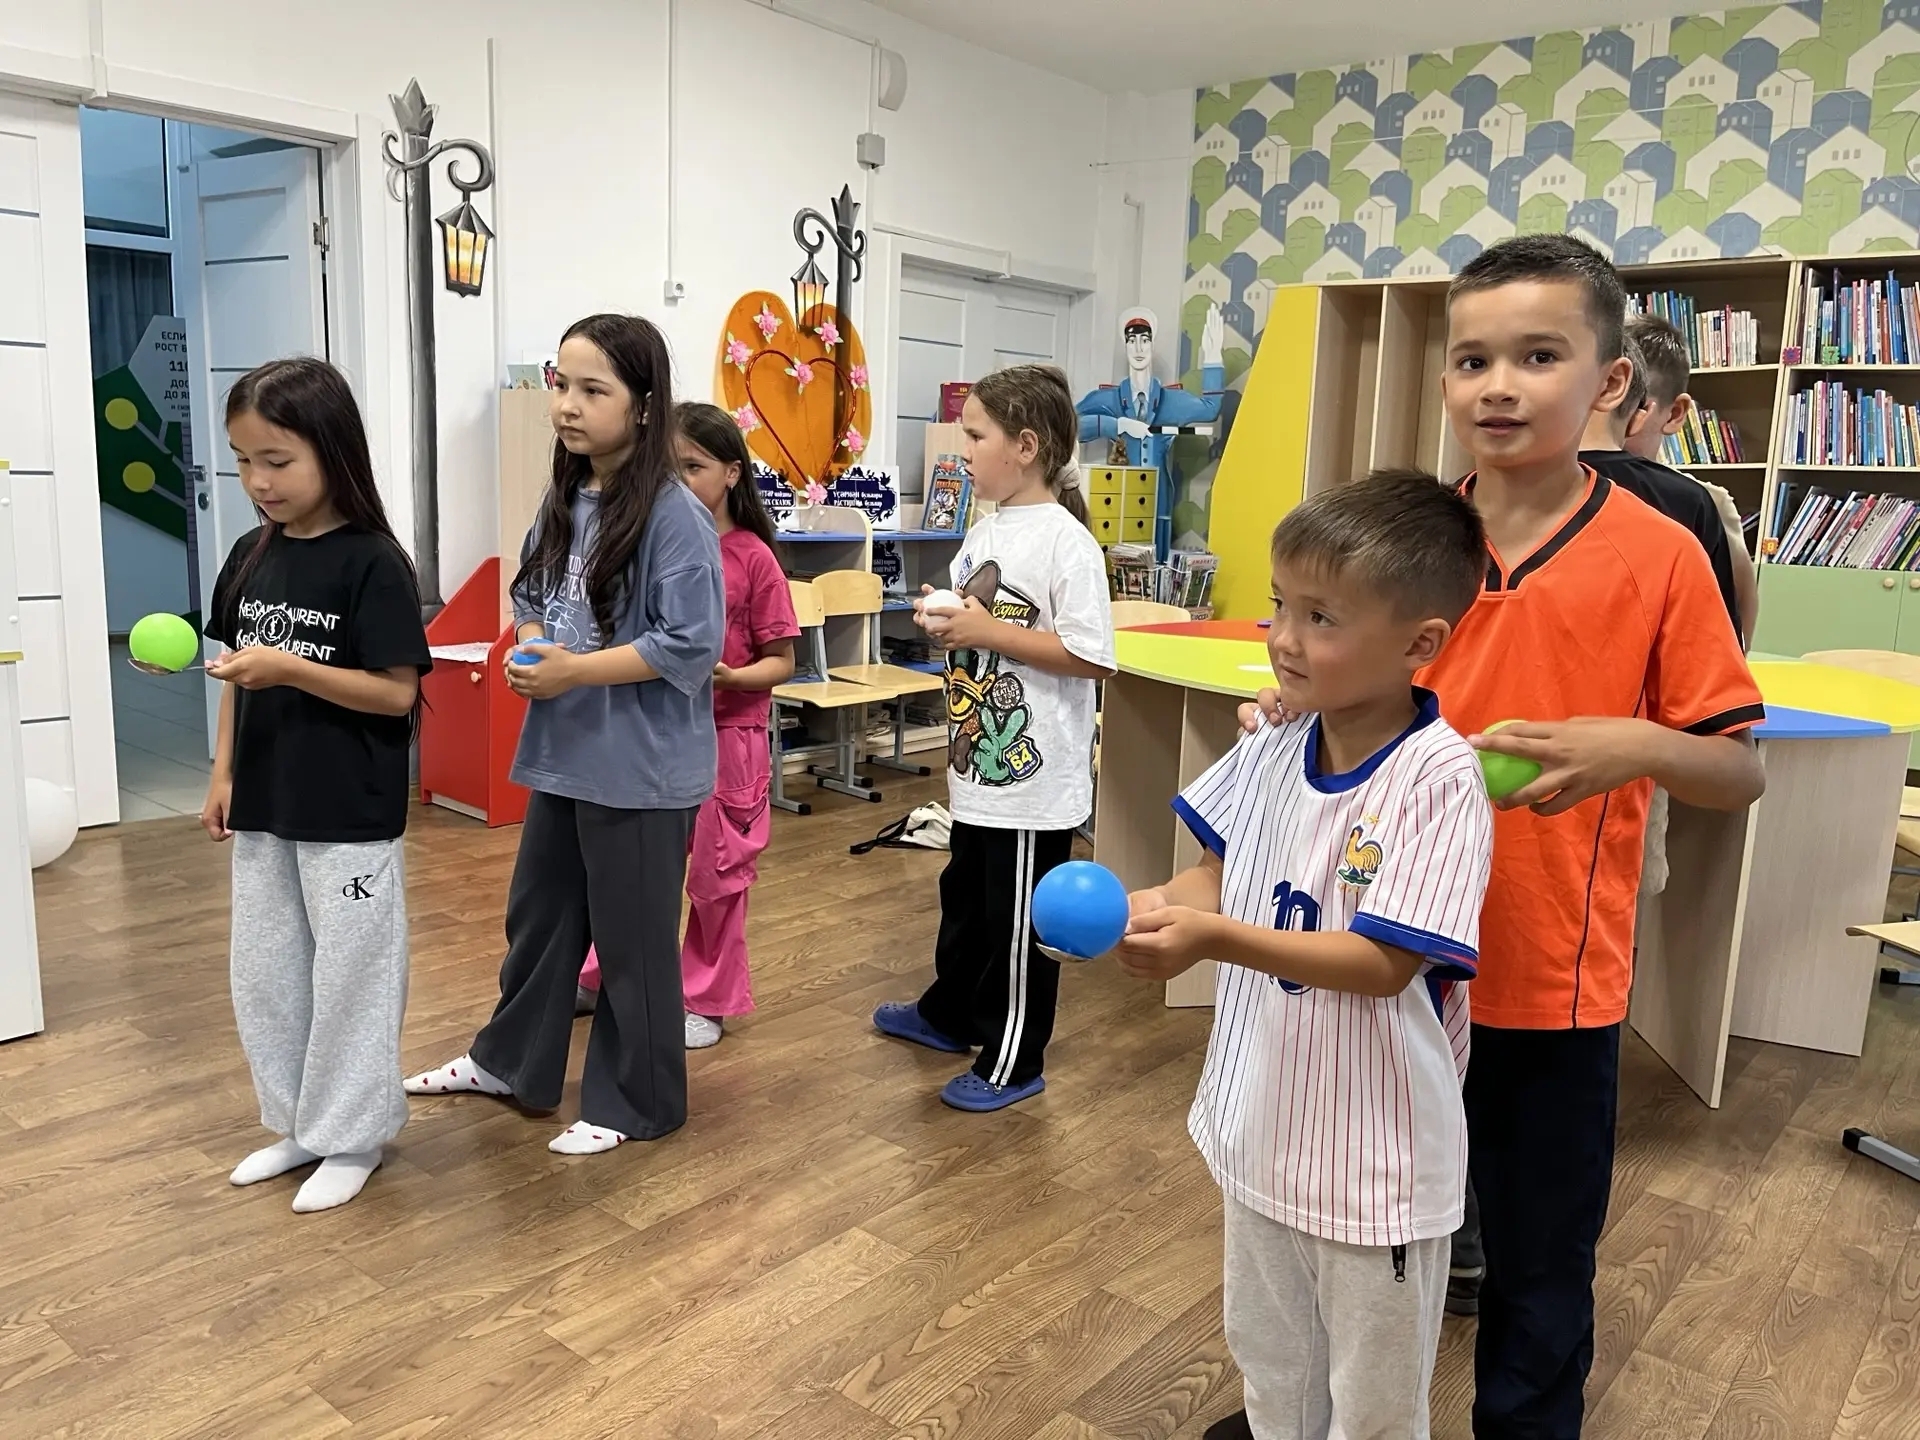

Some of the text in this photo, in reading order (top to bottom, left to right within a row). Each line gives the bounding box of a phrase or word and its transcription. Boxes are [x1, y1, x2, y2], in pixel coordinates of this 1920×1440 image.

[161, 331, 187, 341] ЕСЛИ
[155, 342, 178, 352] РОСТ
[164, 390, 178, 400] ДО
[992, 600, 1031, 619] Export
[1010, 747, 1033, 771] 64
